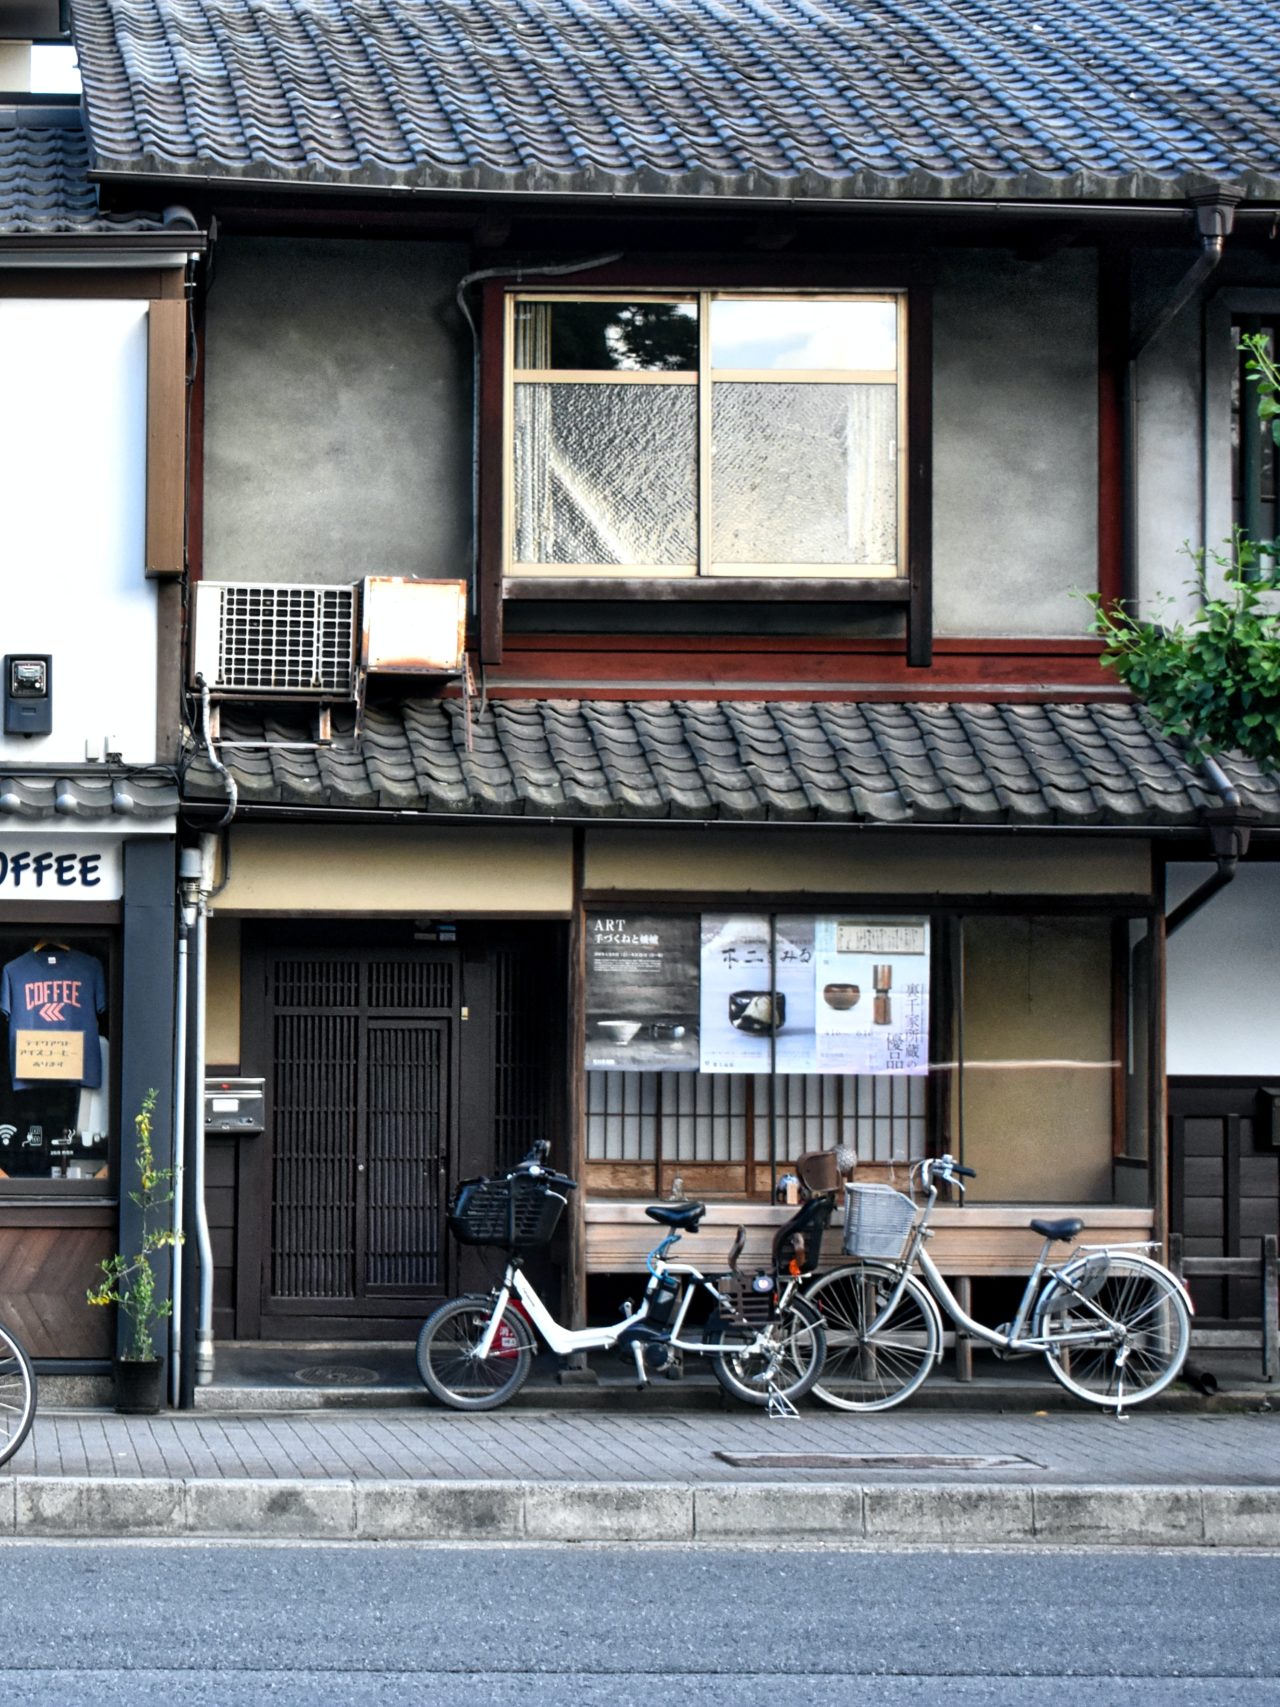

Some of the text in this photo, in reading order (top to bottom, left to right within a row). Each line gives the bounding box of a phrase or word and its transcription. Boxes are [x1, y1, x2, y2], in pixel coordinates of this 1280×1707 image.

[594, 919, 625, 932] ART
[594, 934, 659, 945] 手づくねと
[721, 948, 812, 969] 不二みる
[25, 980, 81, 1010] COFFEE
